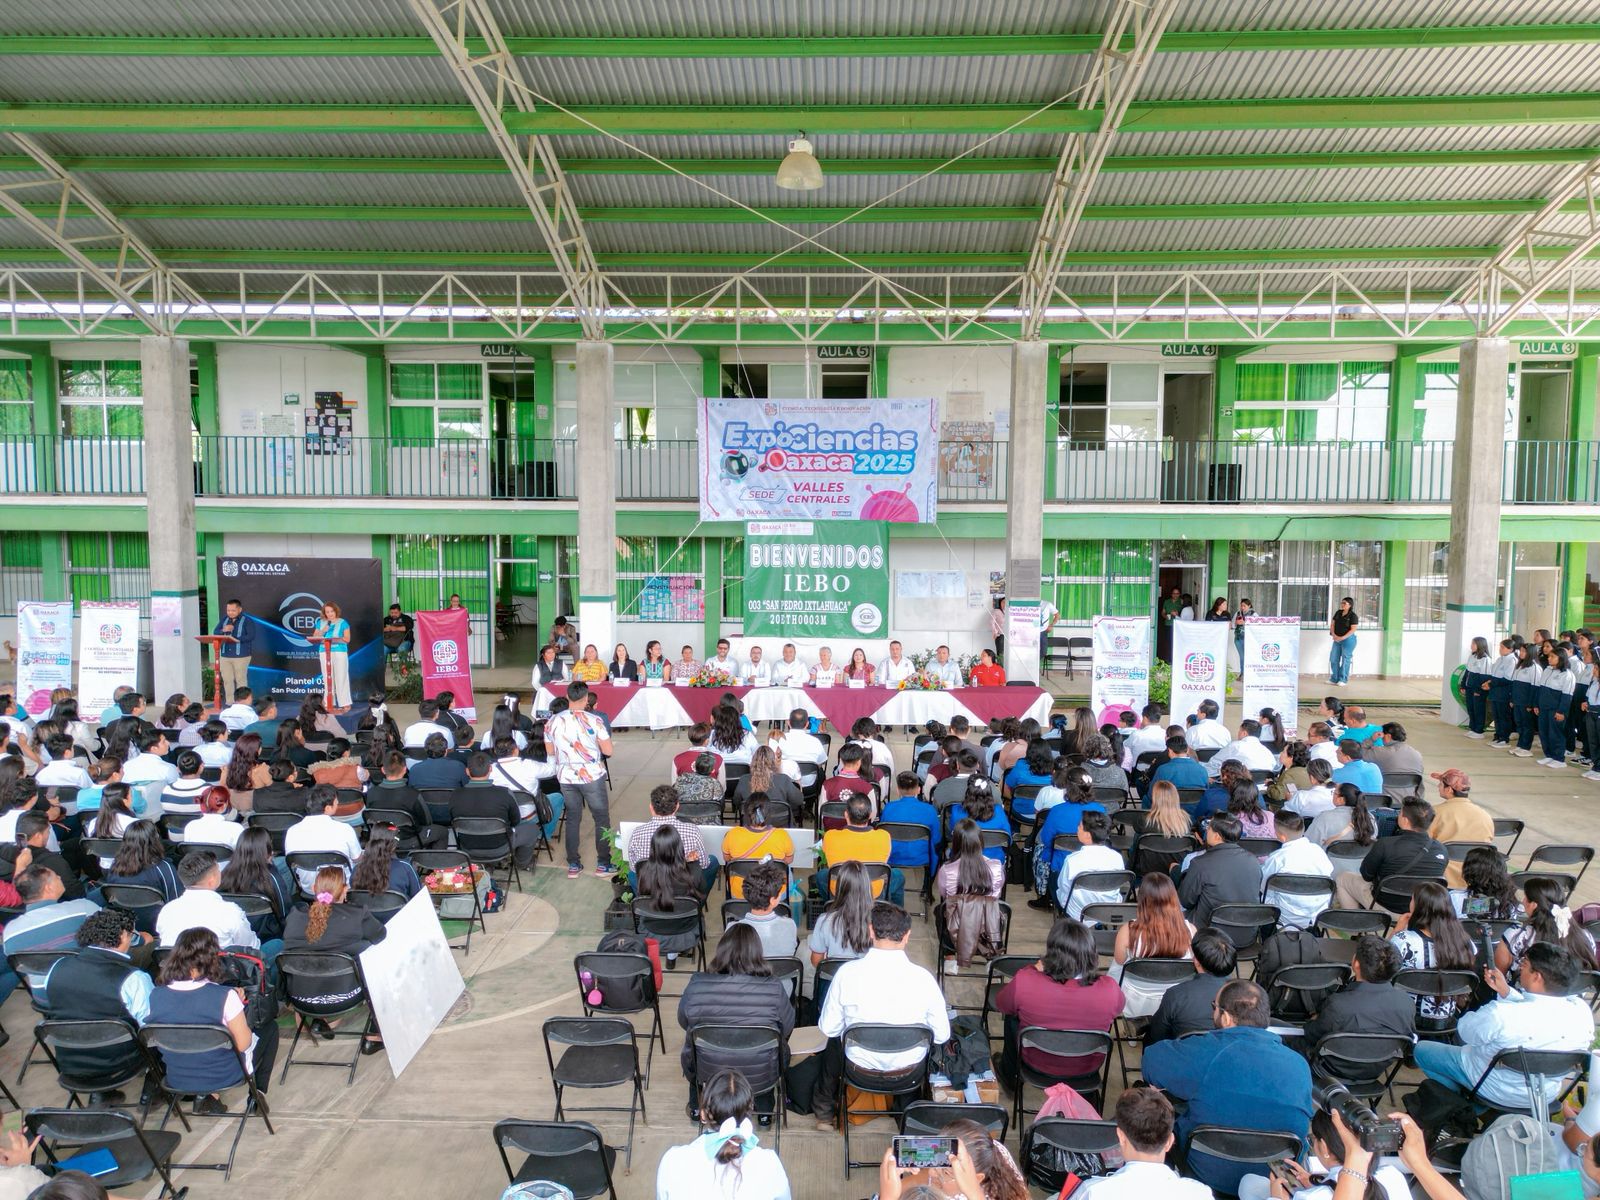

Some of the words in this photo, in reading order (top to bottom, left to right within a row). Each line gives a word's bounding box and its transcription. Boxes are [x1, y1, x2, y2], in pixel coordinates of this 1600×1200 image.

[482, 345, 517, 355] AULA
[820, 346, 853, 357] AULA
[858, 346, 868, 357] 5
[1163, 344, 1199, 355] AULA
[1203, 344, 1214, 355] 4
[1521, 342, 1559, 353] AULA
[1562, 342, 1575, 354] 3
[765, 448, 853, 473] Oaxaca
[855, 453, 914, 473] 2025
[793, 482, 844, 493] VALLES
[748, 490, 775, 499] SEDE
[786, 495, 850, 504] CENTRALES
[751, 544, 884, 569] BIENVENIDOS
[241, 563, 291, 572] OAXACA
[783, 573, 850, 592] IEBO
[748, 600, 761, 611] 003
[781, 600, 803, 611] PEDRO
[285, 677, 314, 685] Plantel
[1181, 684, 1216, 692] OAXACA
